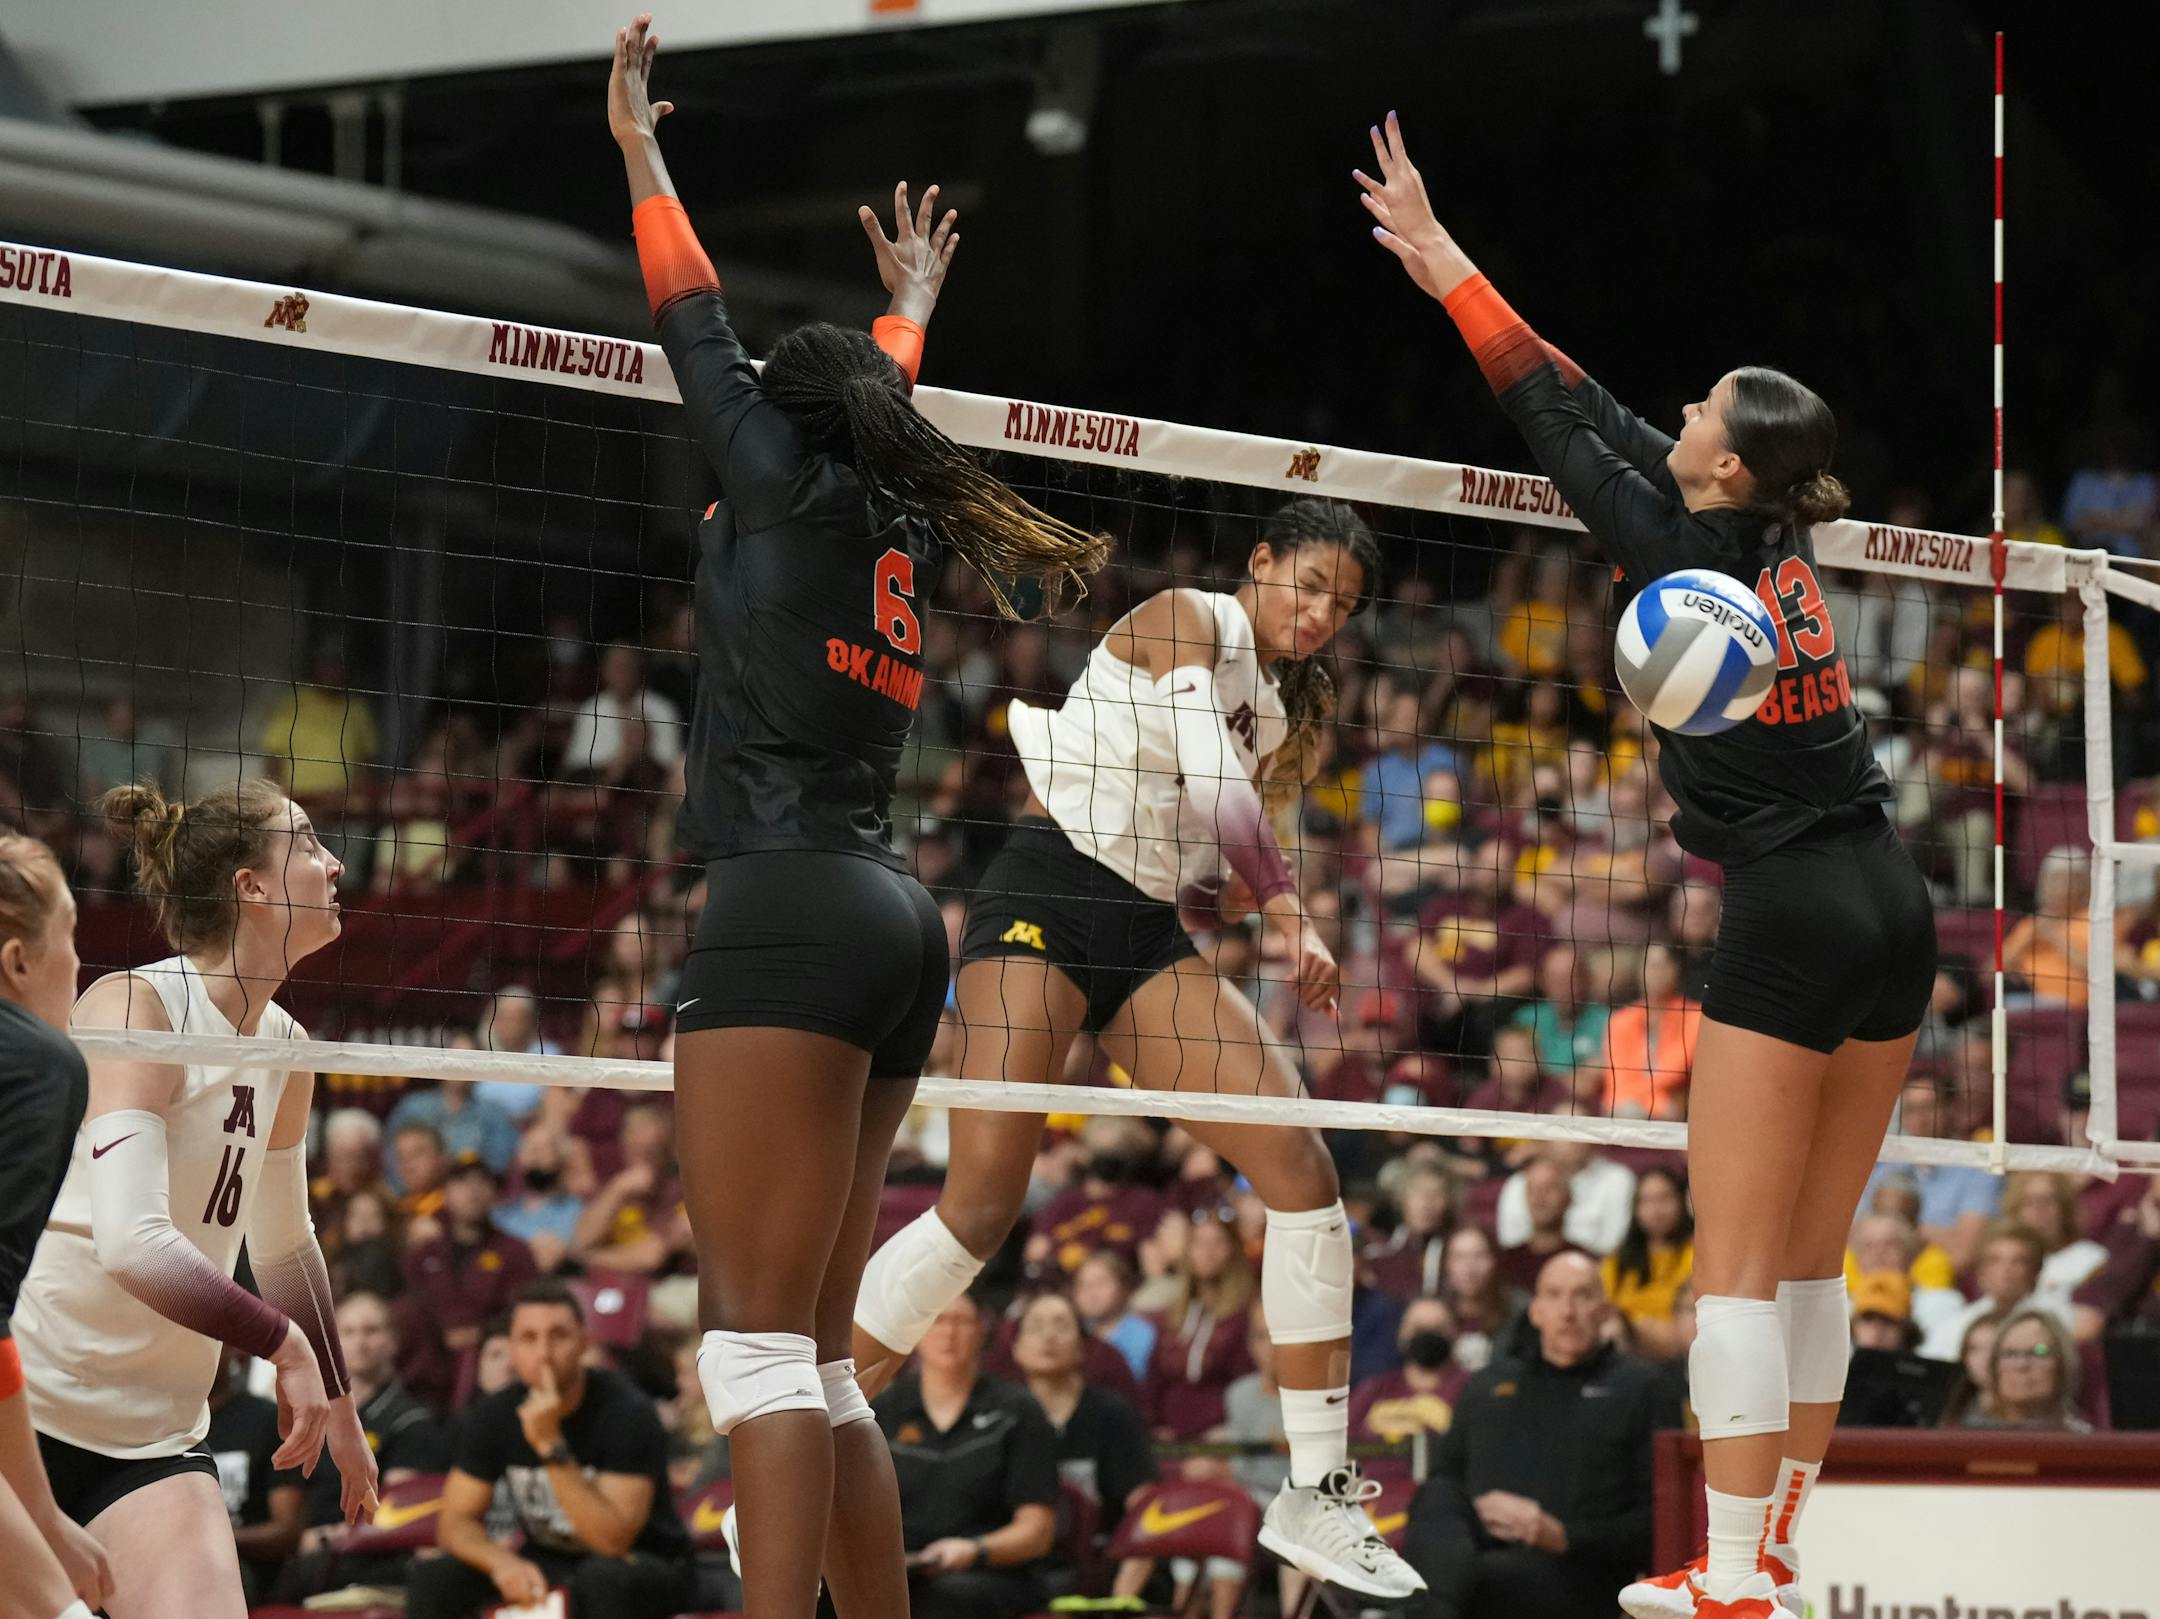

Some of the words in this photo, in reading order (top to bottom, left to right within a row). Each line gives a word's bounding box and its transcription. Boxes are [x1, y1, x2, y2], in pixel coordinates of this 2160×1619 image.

[0, 246, 71, 298] SOTA
[489, 322, 644, 384] MINNESOTA
[1004, 402, 1140, 457] MINNESOTA
[1459, 467, 1575, 518] MINNESO
[1864, 526, 1973, 572] MINNESOTA
[874, 547, 921, 655] 6
[1683, 593, 1763, 648] molten
[1756, 555, 1835, 671] 13
[826, 638, 923, 711] OKAMM
[1000, 919, 1046, 950] M
[223, 1085, 256, 1138] M
[202, 1144, 246, 1228] 16
